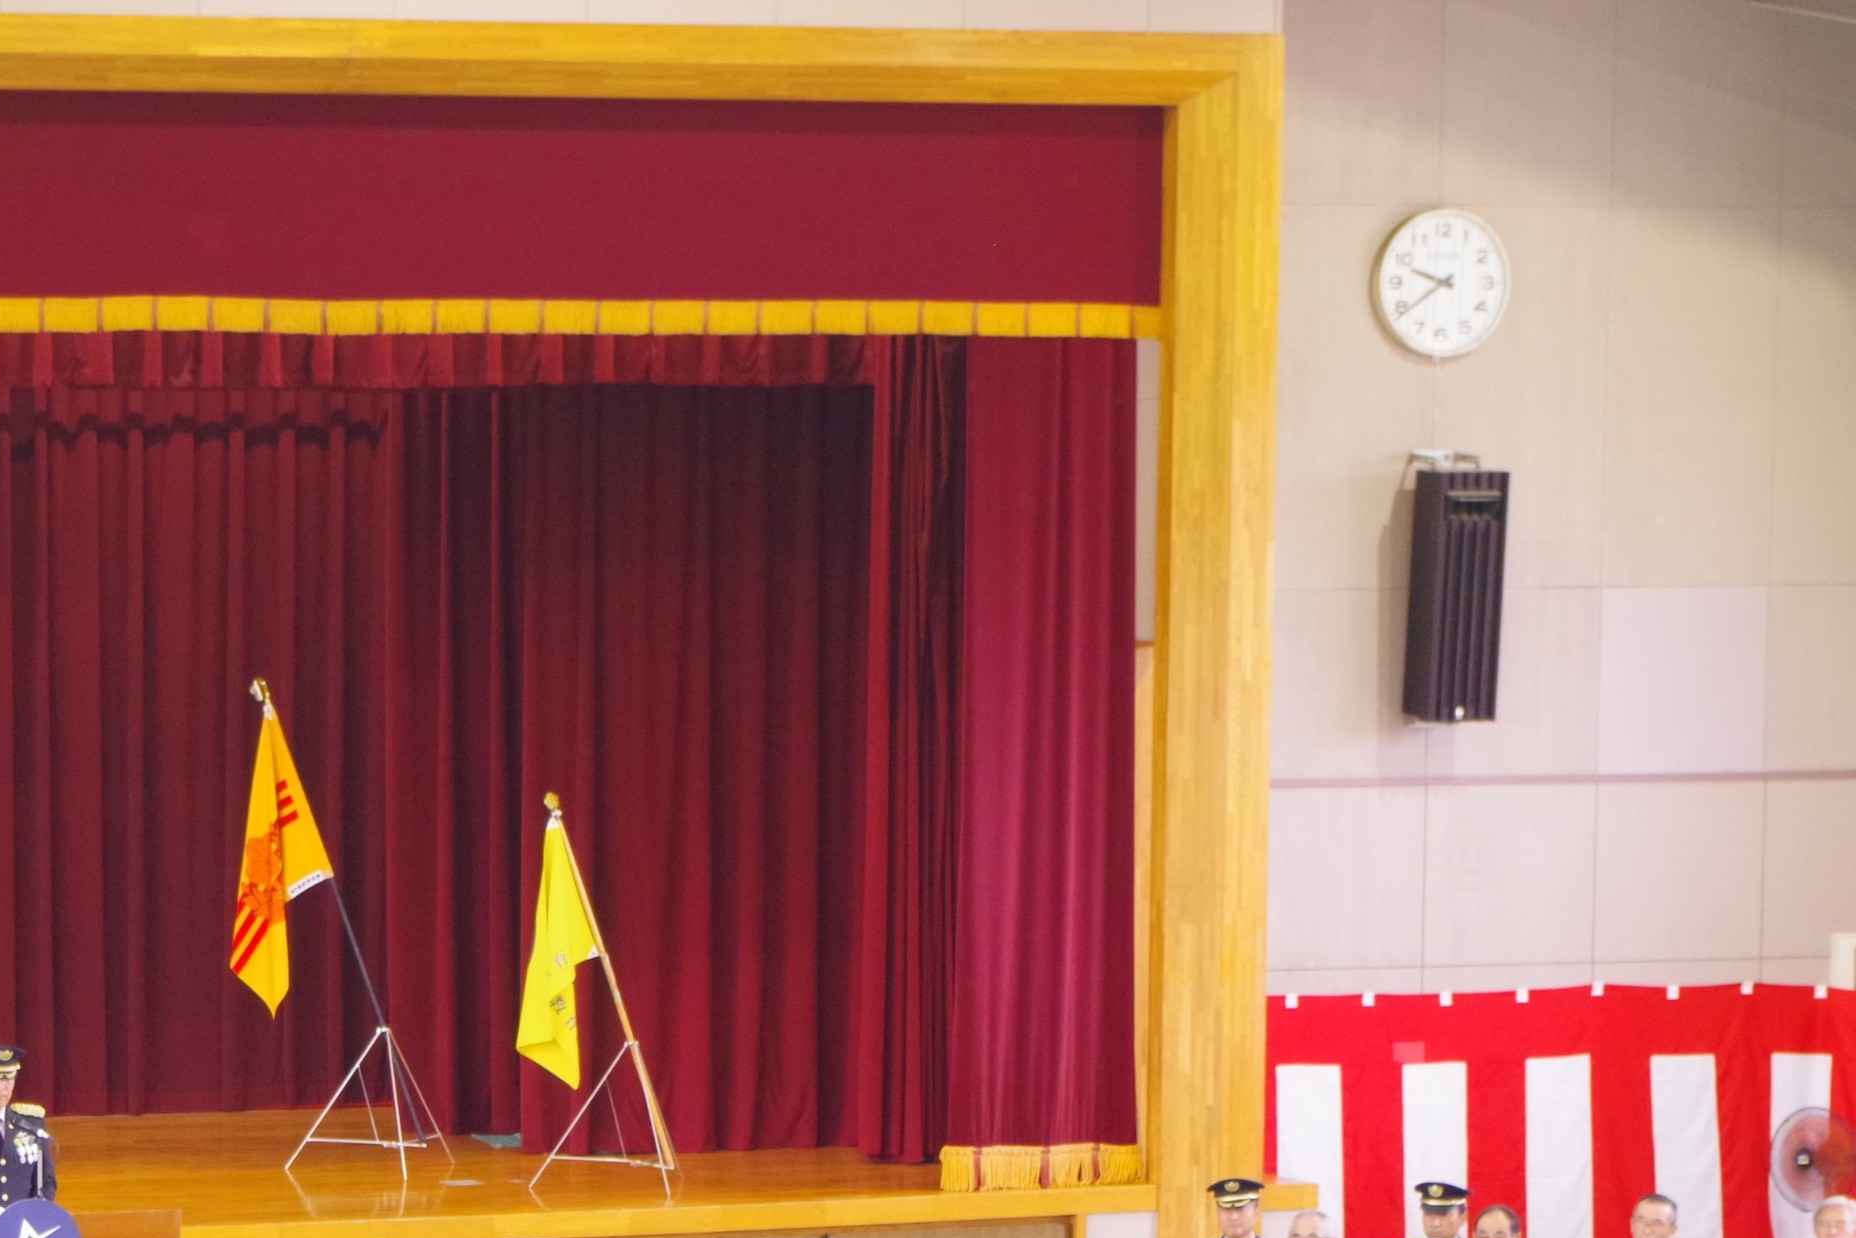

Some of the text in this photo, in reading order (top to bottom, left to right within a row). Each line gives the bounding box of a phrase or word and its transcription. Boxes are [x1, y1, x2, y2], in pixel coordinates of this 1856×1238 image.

[1435, 223, 1453, 239] 12
[1396, 252, 1414, 267] 10
[1476, 250, 1489, 265] 2
[1389, 275, 1403, 291] 9
[1482, 276, 1495, 291] 3
[1412, 320, 1426, 335] 7
[1433, 327, 1448, 342] 6
[1458, 320, 1472, 335] 5
